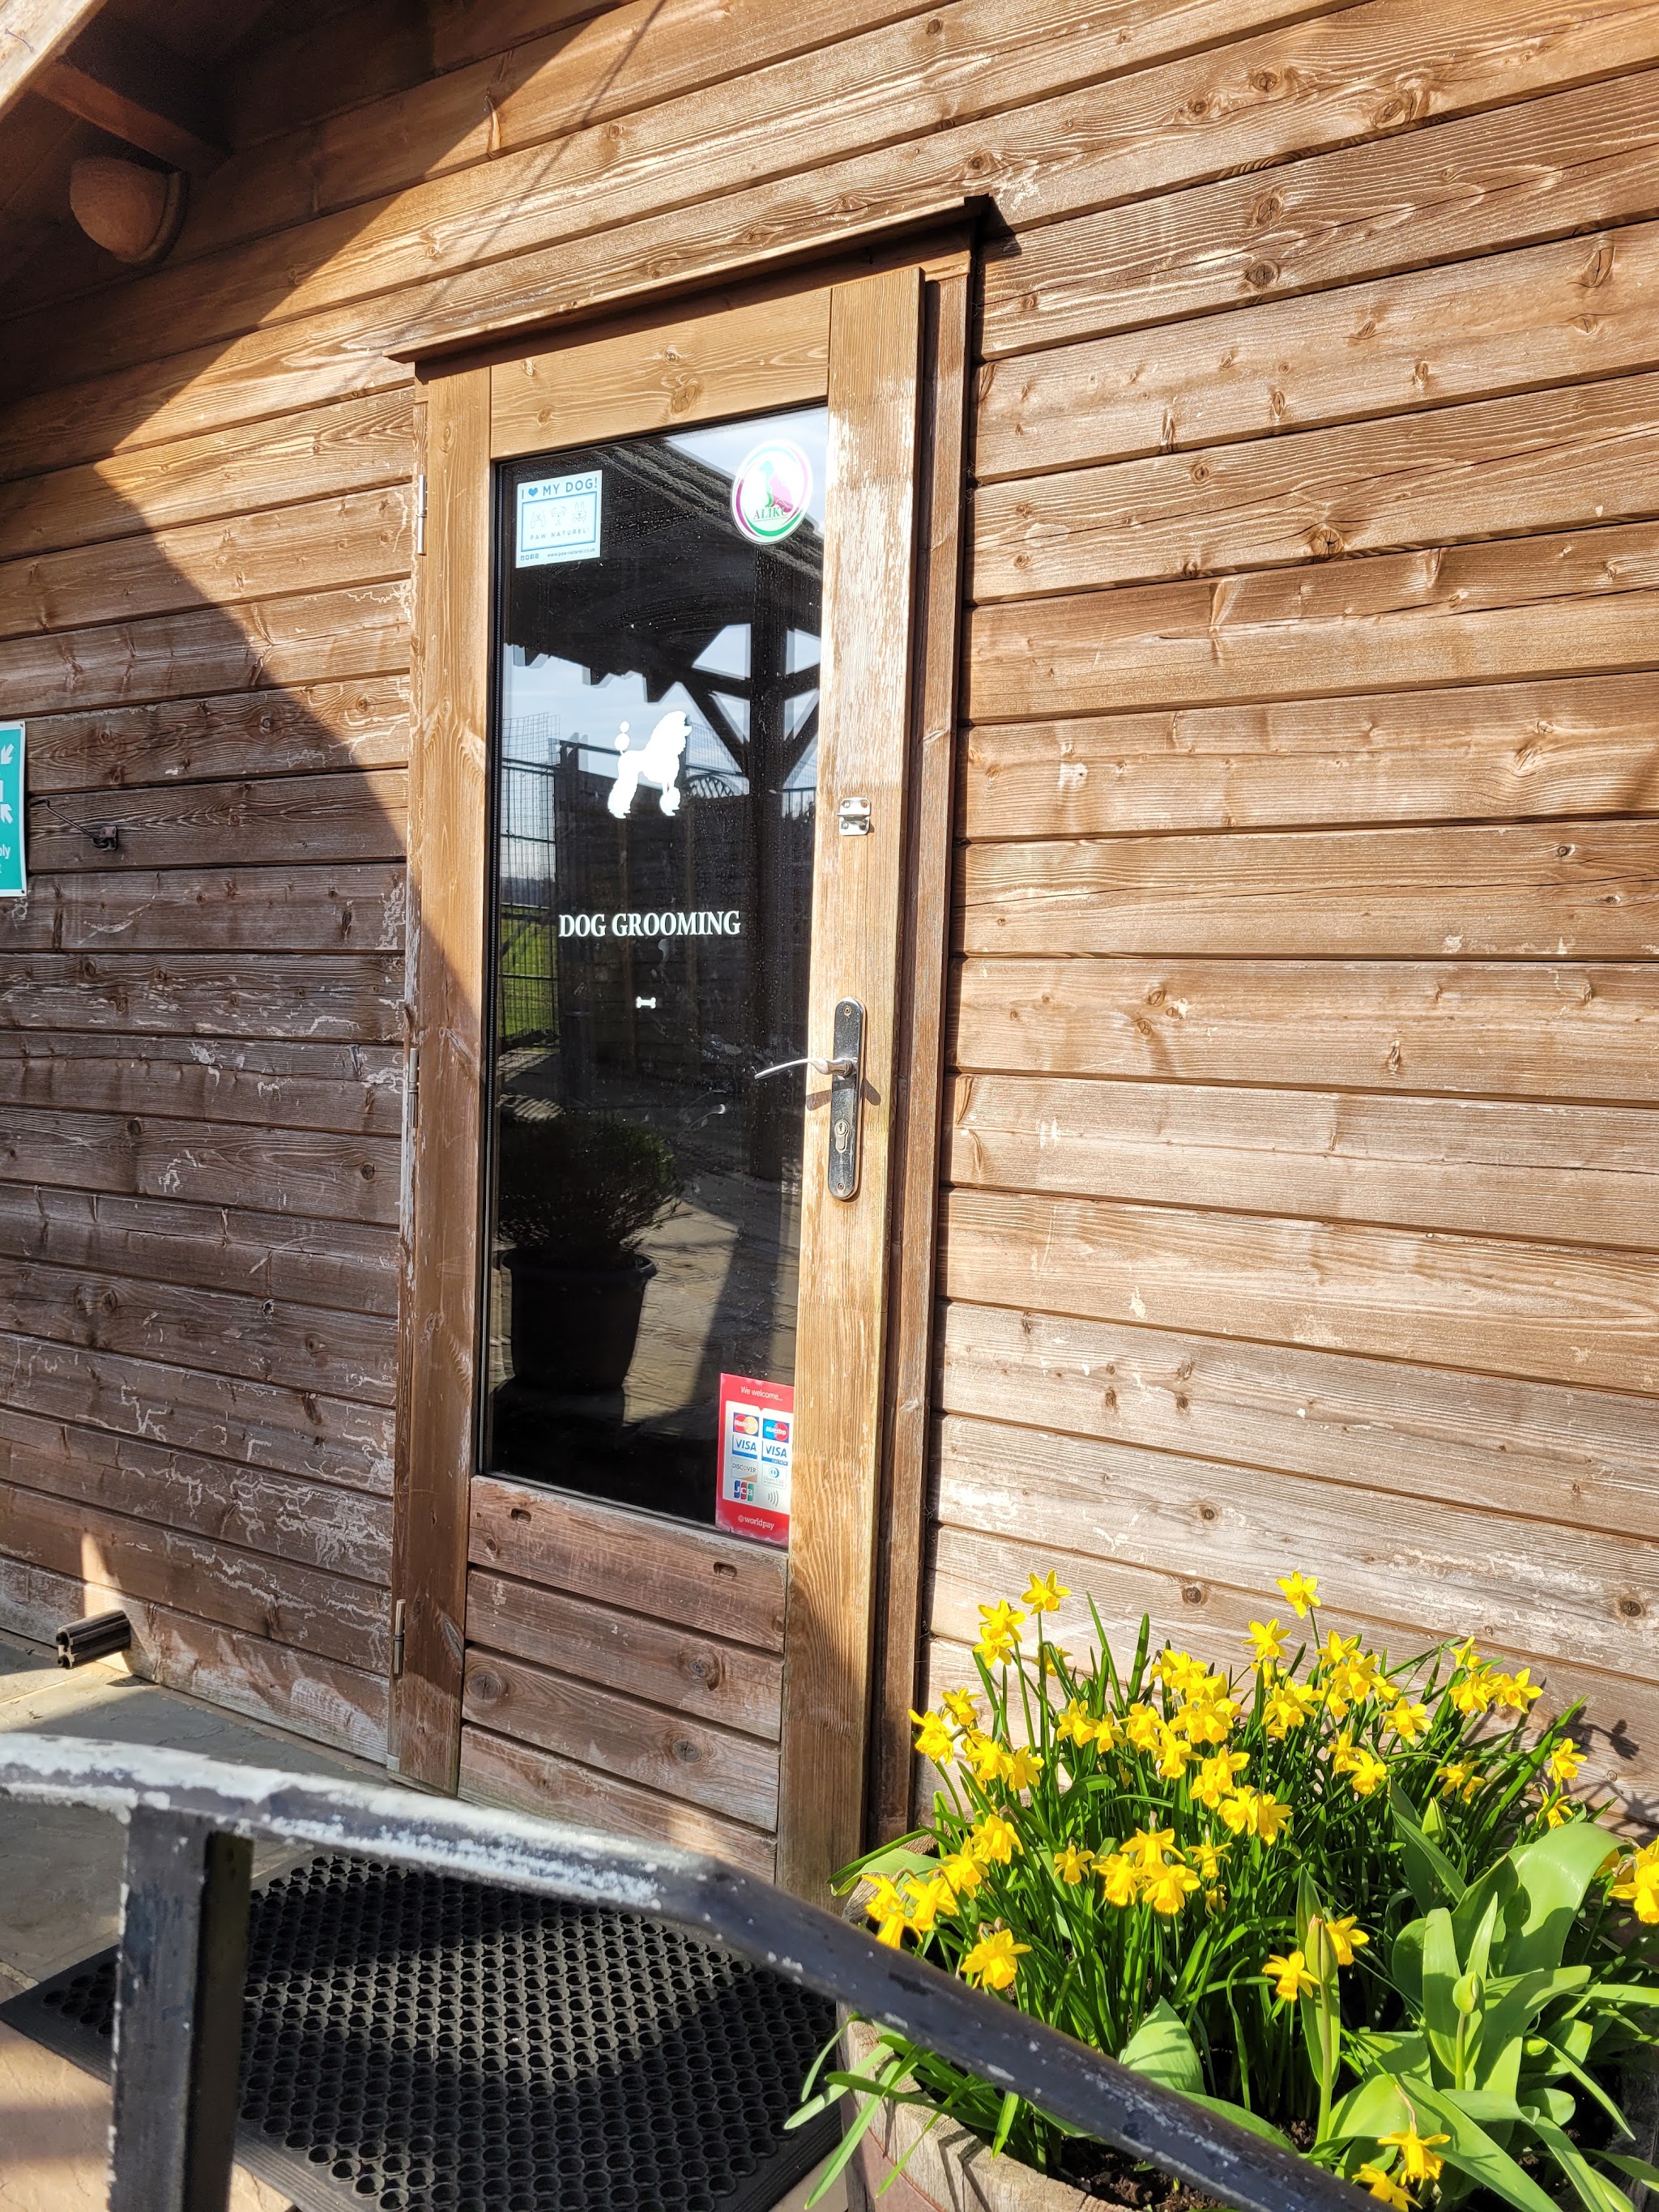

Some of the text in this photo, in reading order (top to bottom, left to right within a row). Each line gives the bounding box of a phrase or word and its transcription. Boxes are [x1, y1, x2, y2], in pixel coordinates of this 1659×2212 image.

[522, 477, 598, 500] I MY DOG!
[551, 528, 586, 538] NATUREL
[558, 910, 741, 937] DOG GROOMING
[740, 1386, 783, 1401] We welcome...
[765, 1426, 787, 1435] Maestro
[736, 1438, 757, 1451] VISA
[766, 1445, 787, 1458] VISA
[732, 1463, 757, 1473] DISCOVER
[734, 1486, 753, 1496] JCB
[744, 1516, 775, 1531] worldpay
